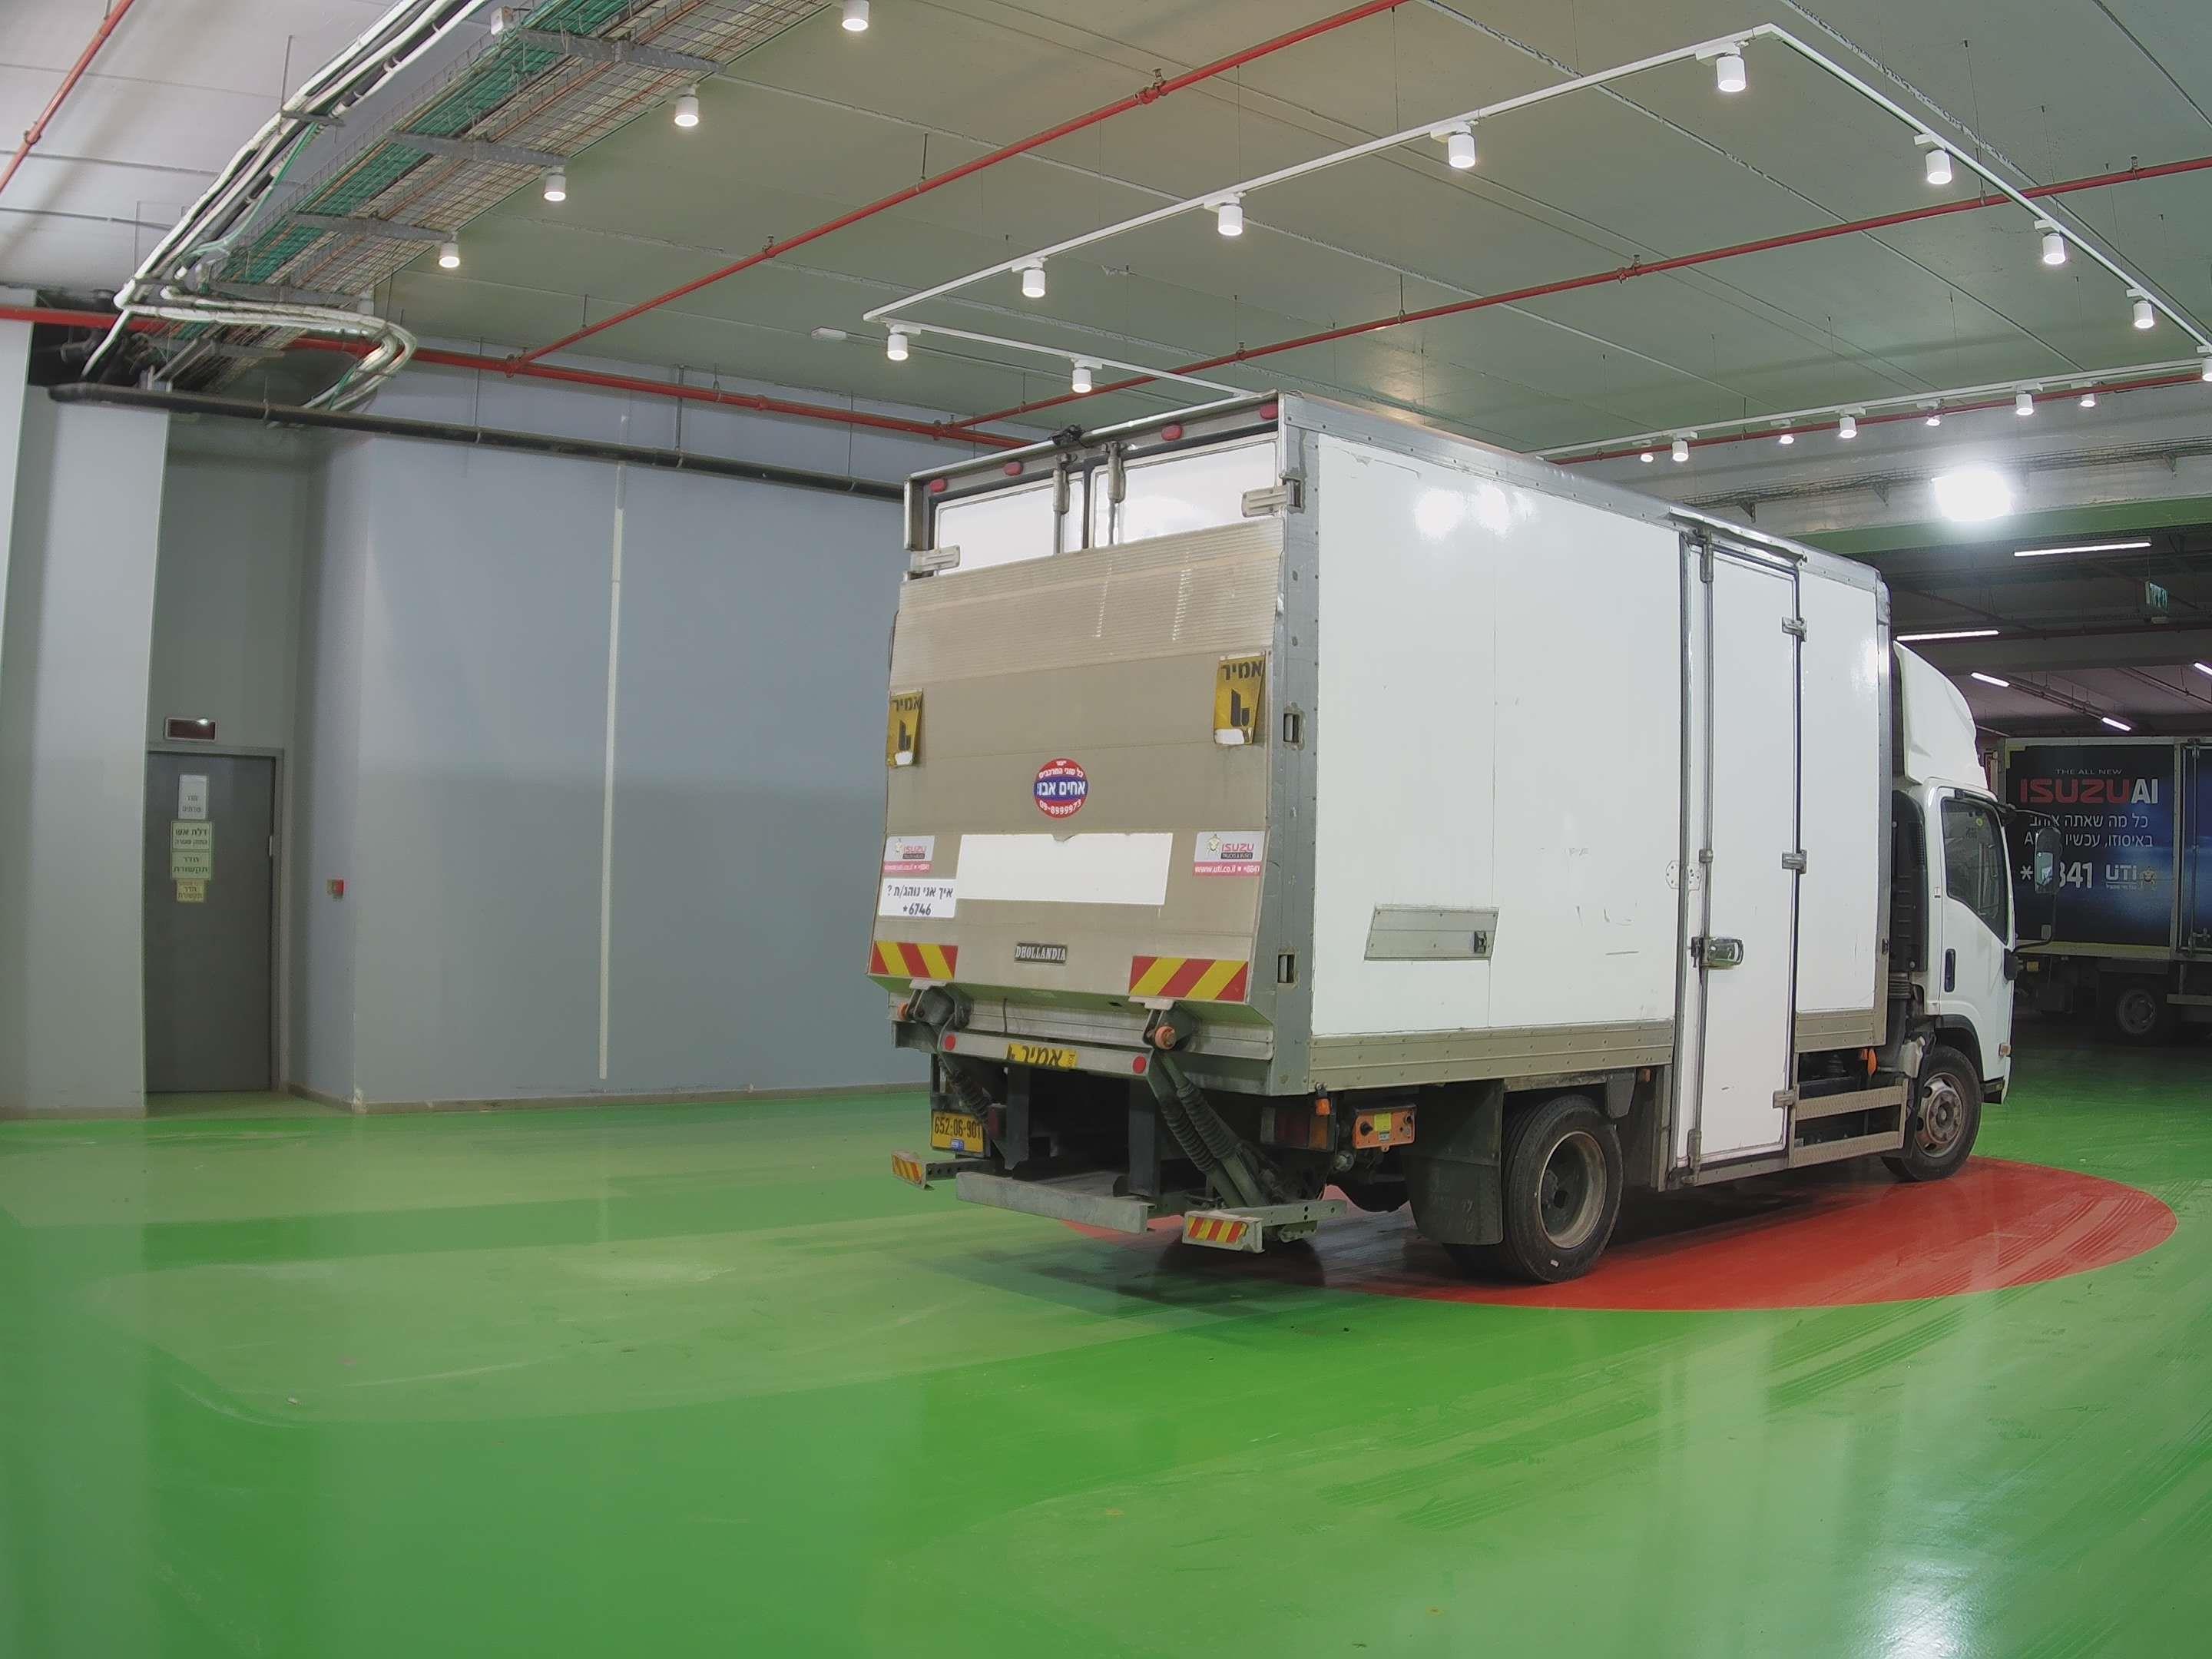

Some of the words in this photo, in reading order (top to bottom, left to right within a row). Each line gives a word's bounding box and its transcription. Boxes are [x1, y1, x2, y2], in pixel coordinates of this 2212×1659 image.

[1220, 660, 1263, 680] אמיר
[891, 694, 923, 712] אמיר
[1076, 767, 1084, 778] כל
[1059, 781, 1086, 795] אחים
[2065, 815, 2103, 827] שאתה
[2109, 816, 2127, 827] מה
[2132, 813, 2149, 827] כל
[1222, 843, 1254, 852] ISUZU
[2065, 834, 2101, 848] עכשיו
[923, 886, 936, 897] אני
[939, 887, 953, 899] איך
[1015, 945, 1065, 960] DHOLLANDIA
[1022, 1045, 1063, 1065] אמיר
